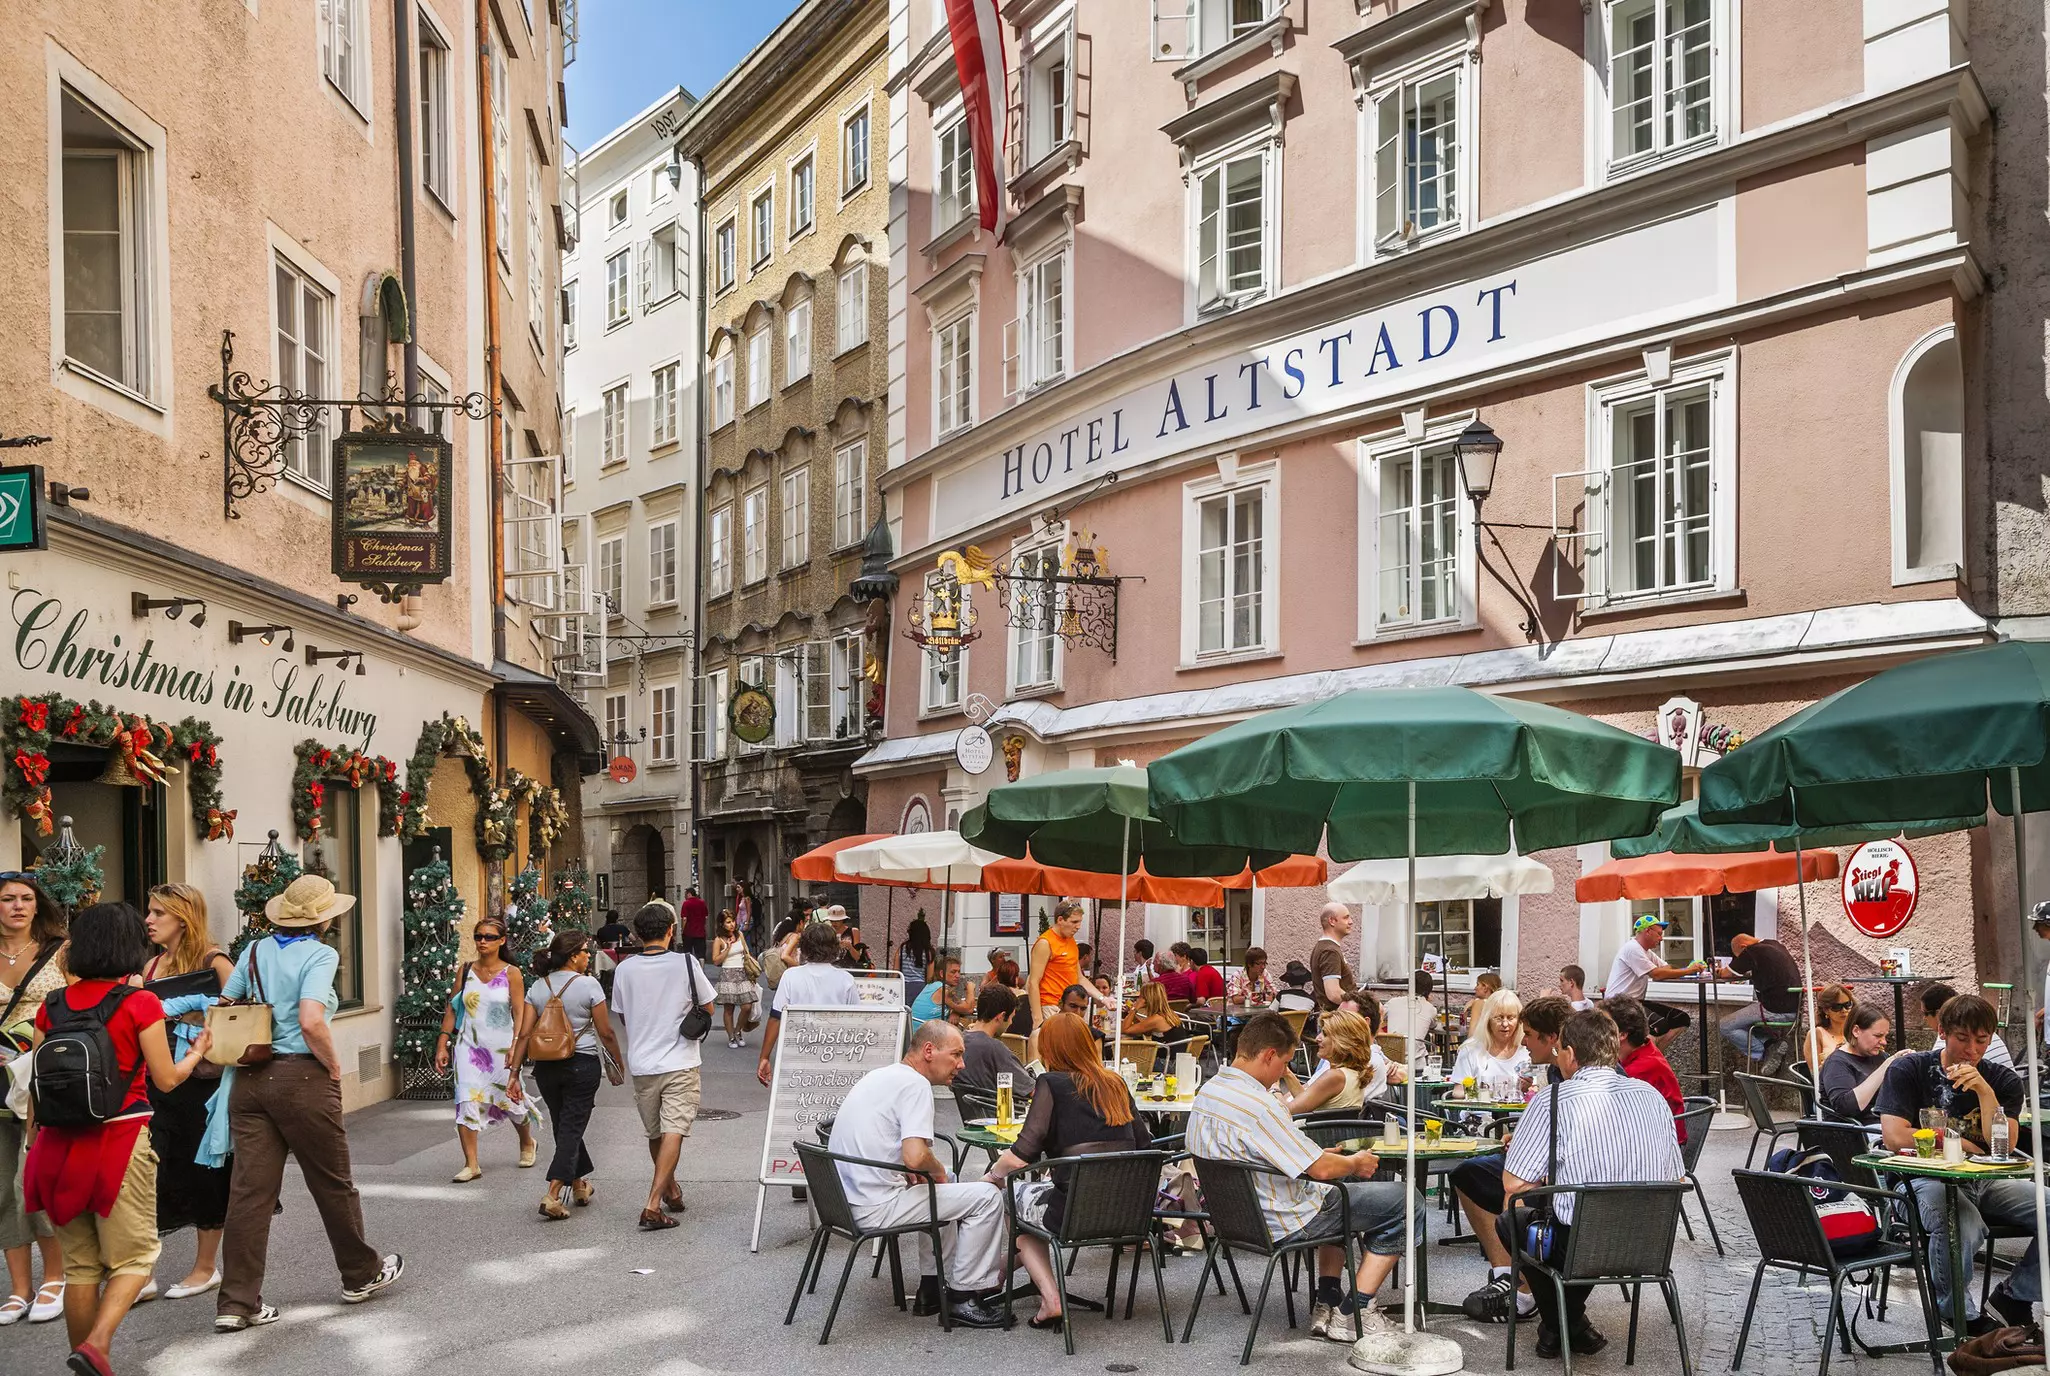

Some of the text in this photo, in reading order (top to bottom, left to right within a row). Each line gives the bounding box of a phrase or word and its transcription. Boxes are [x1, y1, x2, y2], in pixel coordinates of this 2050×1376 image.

[1001, 279, 1517, 500] HOTEL ALTSTADT
[360, 538, 424, 552] Christmas
[361, 553, 423, 571] Salzburg
[11, 588, 377, 754] Christmas in Salzburg
[1852, 866, 1882, 886] Stiegl
[1853, 878, 1891, 902] HELL
[799, 1044, 818, 1055] von
[797, 1092, 847, 1108] Kleine
[795, 1109, 838, 1130] Geric
